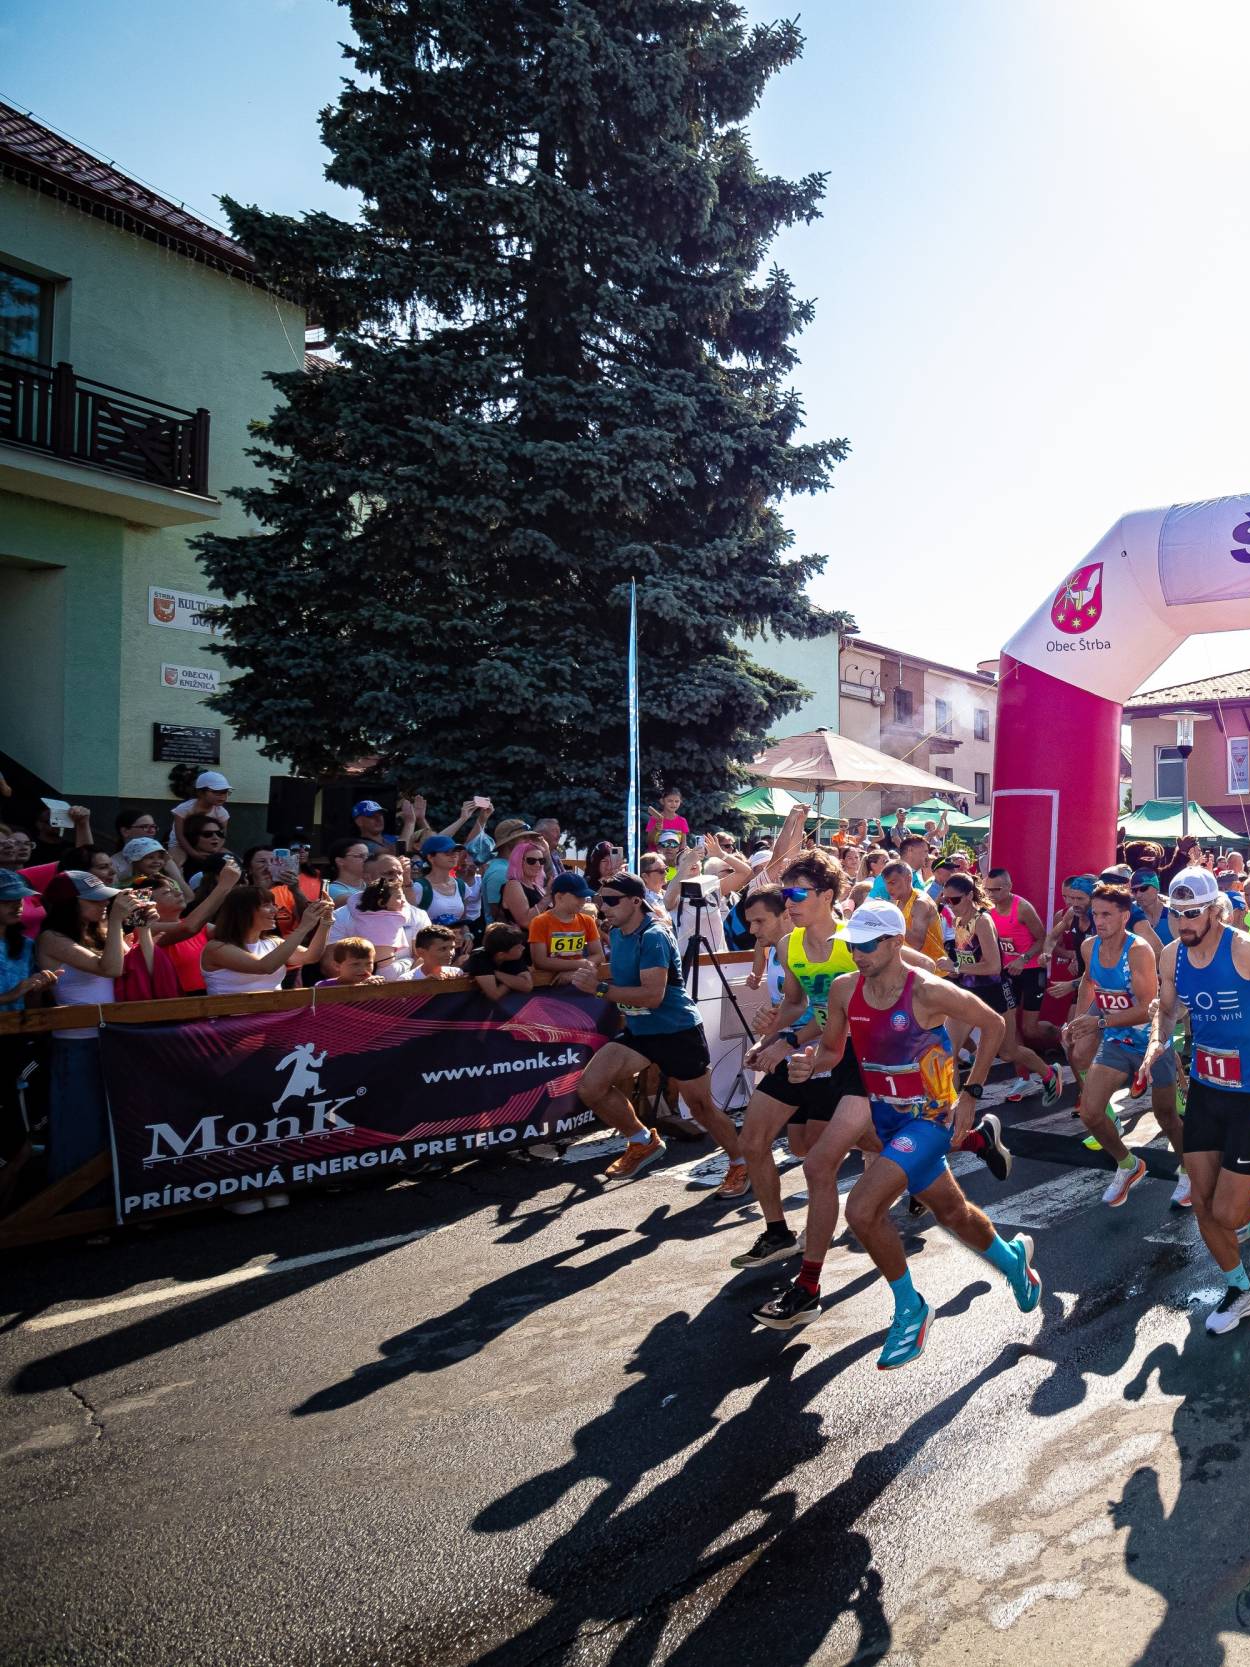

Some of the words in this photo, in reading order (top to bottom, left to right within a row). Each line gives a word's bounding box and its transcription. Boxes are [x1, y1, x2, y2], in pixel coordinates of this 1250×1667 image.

[1046, 640, 1076, 652] Obec
[1079, 638, 1111, 651] Štrba
[555, 937, 584, 951] 618
[1100, 994, 1129, 1009] 120
[1221, 1011, 1242, 1021] WIN
[422, 1048, 581, 1084] www.monk.sk
[1205, 1056, 1225, 1078] 11
[885, 1076, 897, 1096] 1
[125, 1165, 286, 1214] PRÍRODNÁ
[293, 1147, 406, 1181] ENERGIA
[414, 1137, 457, 1159] PRE
[463, 1128, 517, 1149] TELO
[523, 1122, 549, 1139] AJ
